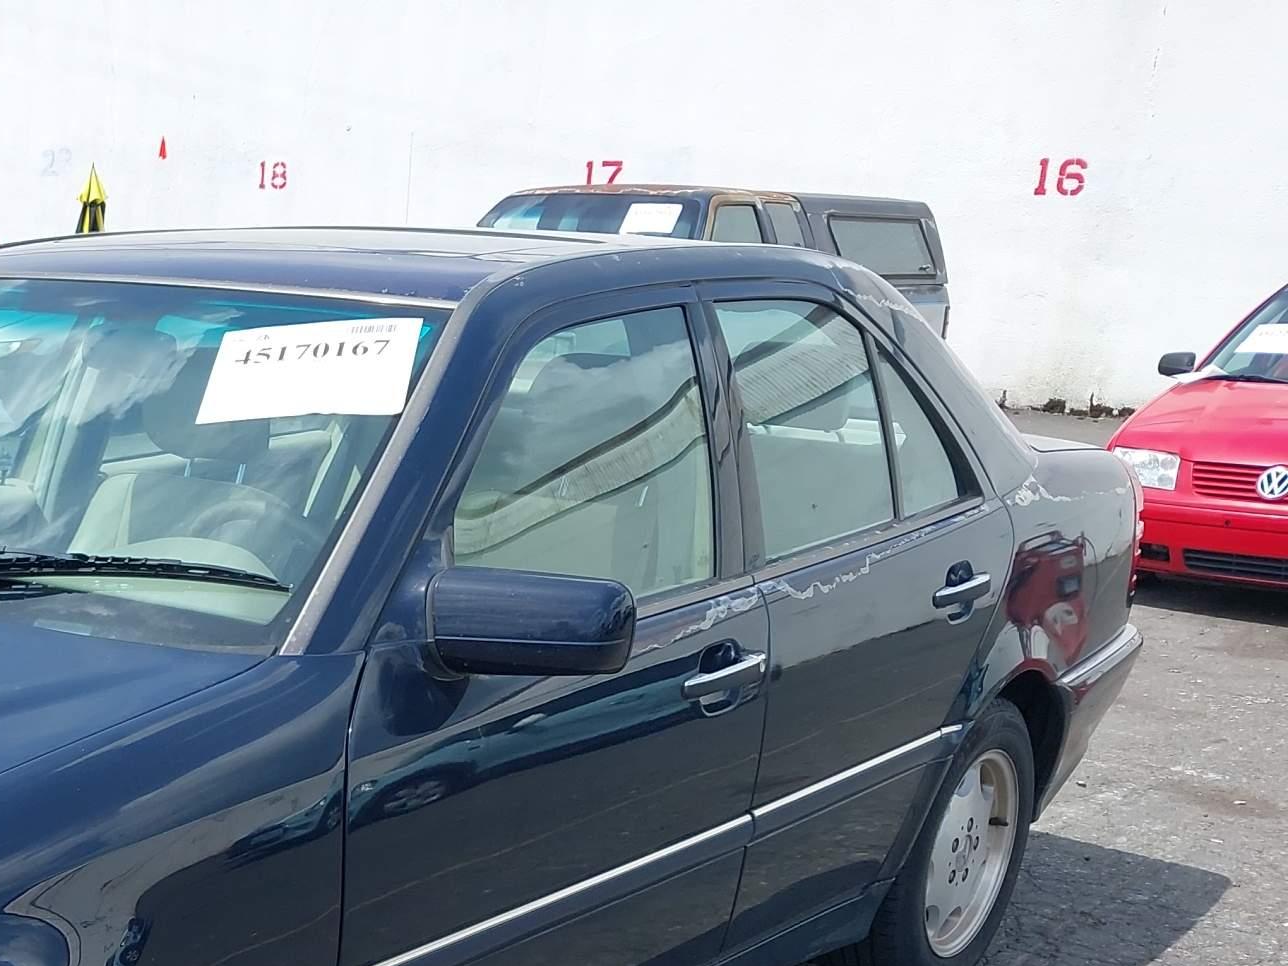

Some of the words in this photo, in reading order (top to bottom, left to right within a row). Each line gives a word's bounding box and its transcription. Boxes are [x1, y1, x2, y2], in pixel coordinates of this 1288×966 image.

[258, 160, 287, 189] 18
[586, 160, 623, 185] 17
[1033, 158, 1088, 196] 16
[234, 339, 391, 365] 45170167
